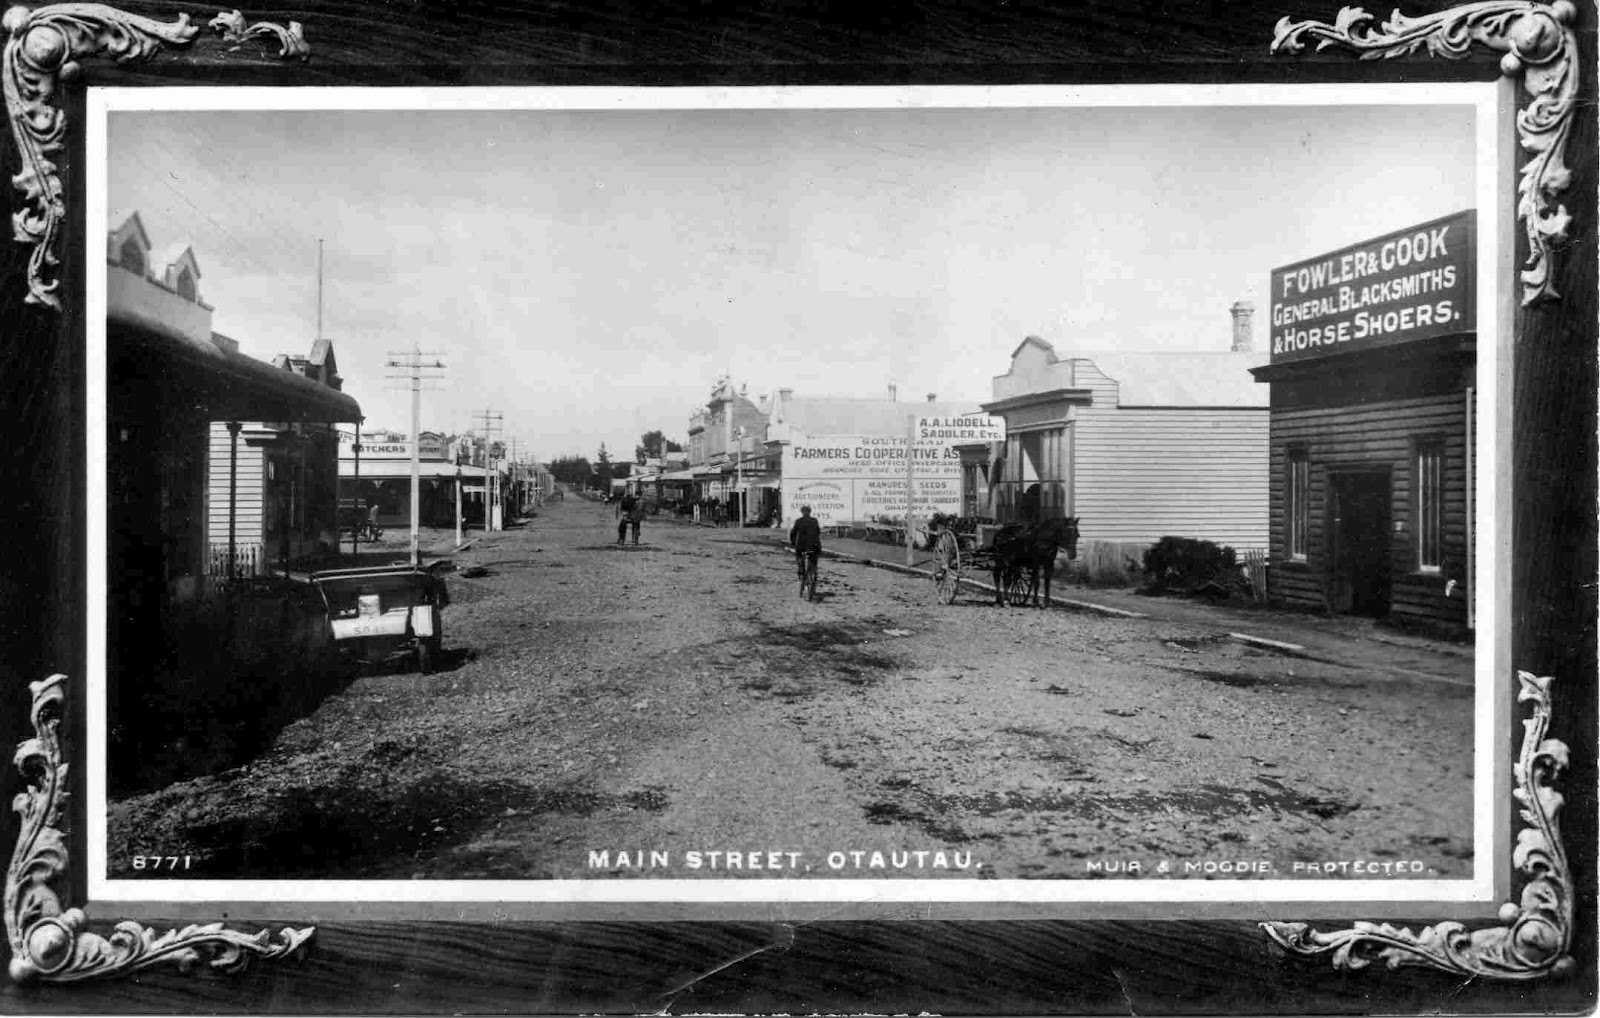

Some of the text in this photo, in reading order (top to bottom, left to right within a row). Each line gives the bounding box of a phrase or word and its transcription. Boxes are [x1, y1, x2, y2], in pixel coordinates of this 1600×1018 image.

[1273, 265, 1457, 327] GENERAL BLACKSMITHS
[1353, 300, 1460, 339] SHOERS.
[794, 446, 850, 459] FARMERS
[861, 438, 944, 446] SOUTHAND
